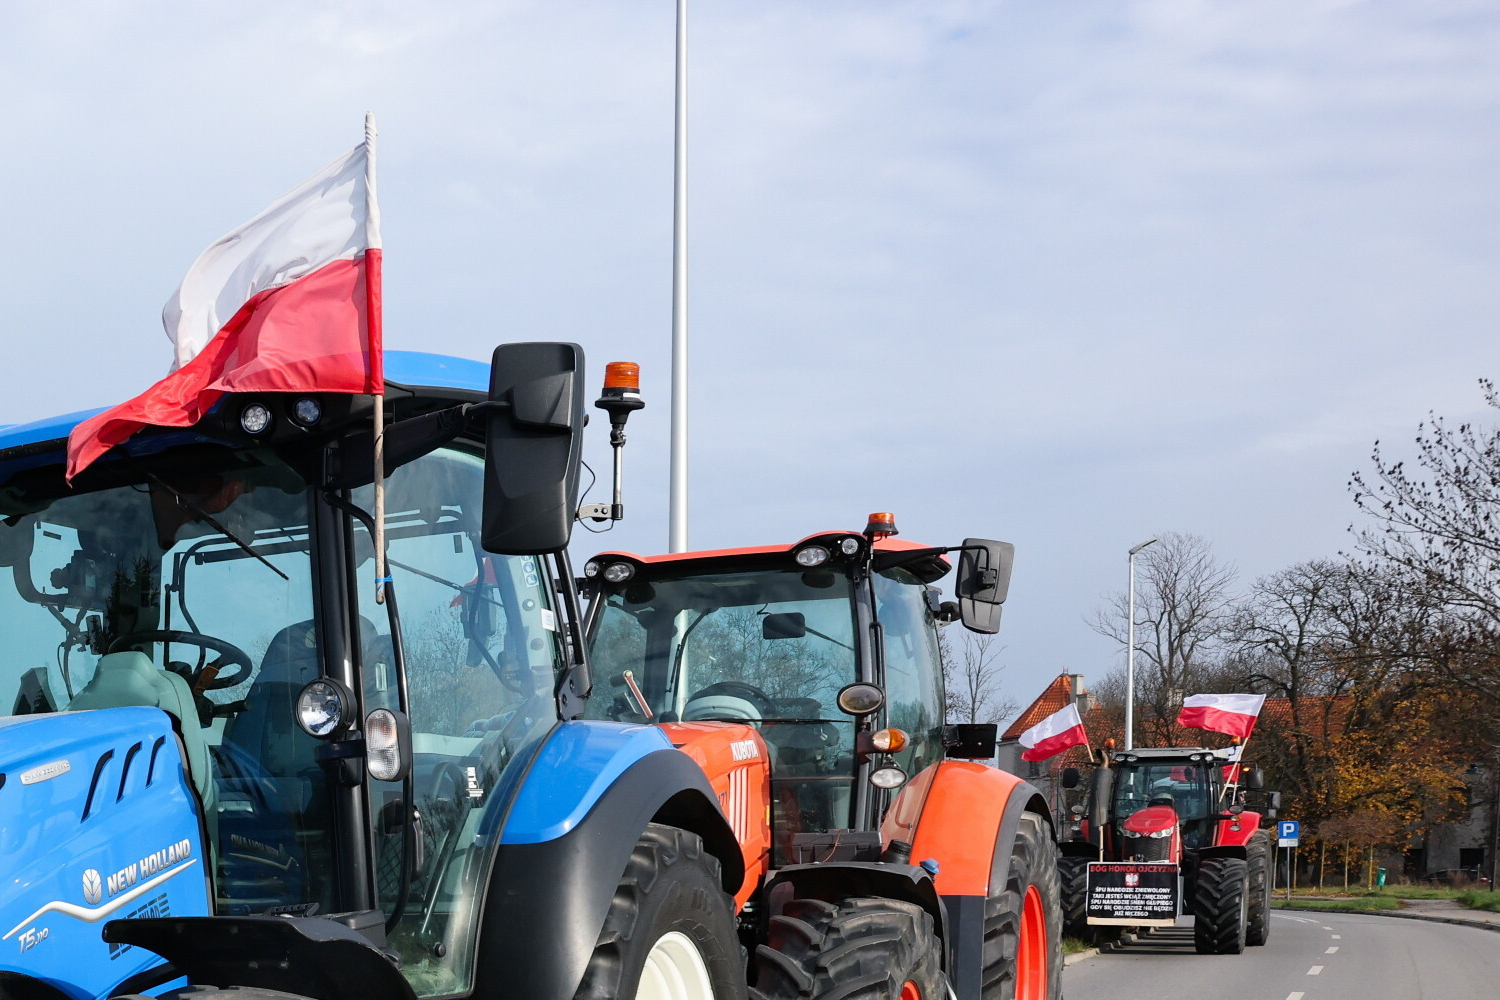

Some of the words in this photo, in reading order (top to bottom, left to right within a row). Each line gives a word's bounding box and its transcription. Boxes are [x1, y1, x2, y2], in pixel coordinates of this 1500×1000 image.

[730, 740, 759, 762] KUBOTA
[1283, 823, 1294, 836] P
[107, 862, 138, 897] NEW
[139, 838, 192, 880] HOLLAND
[18, 927, 49, 954] T5.110
